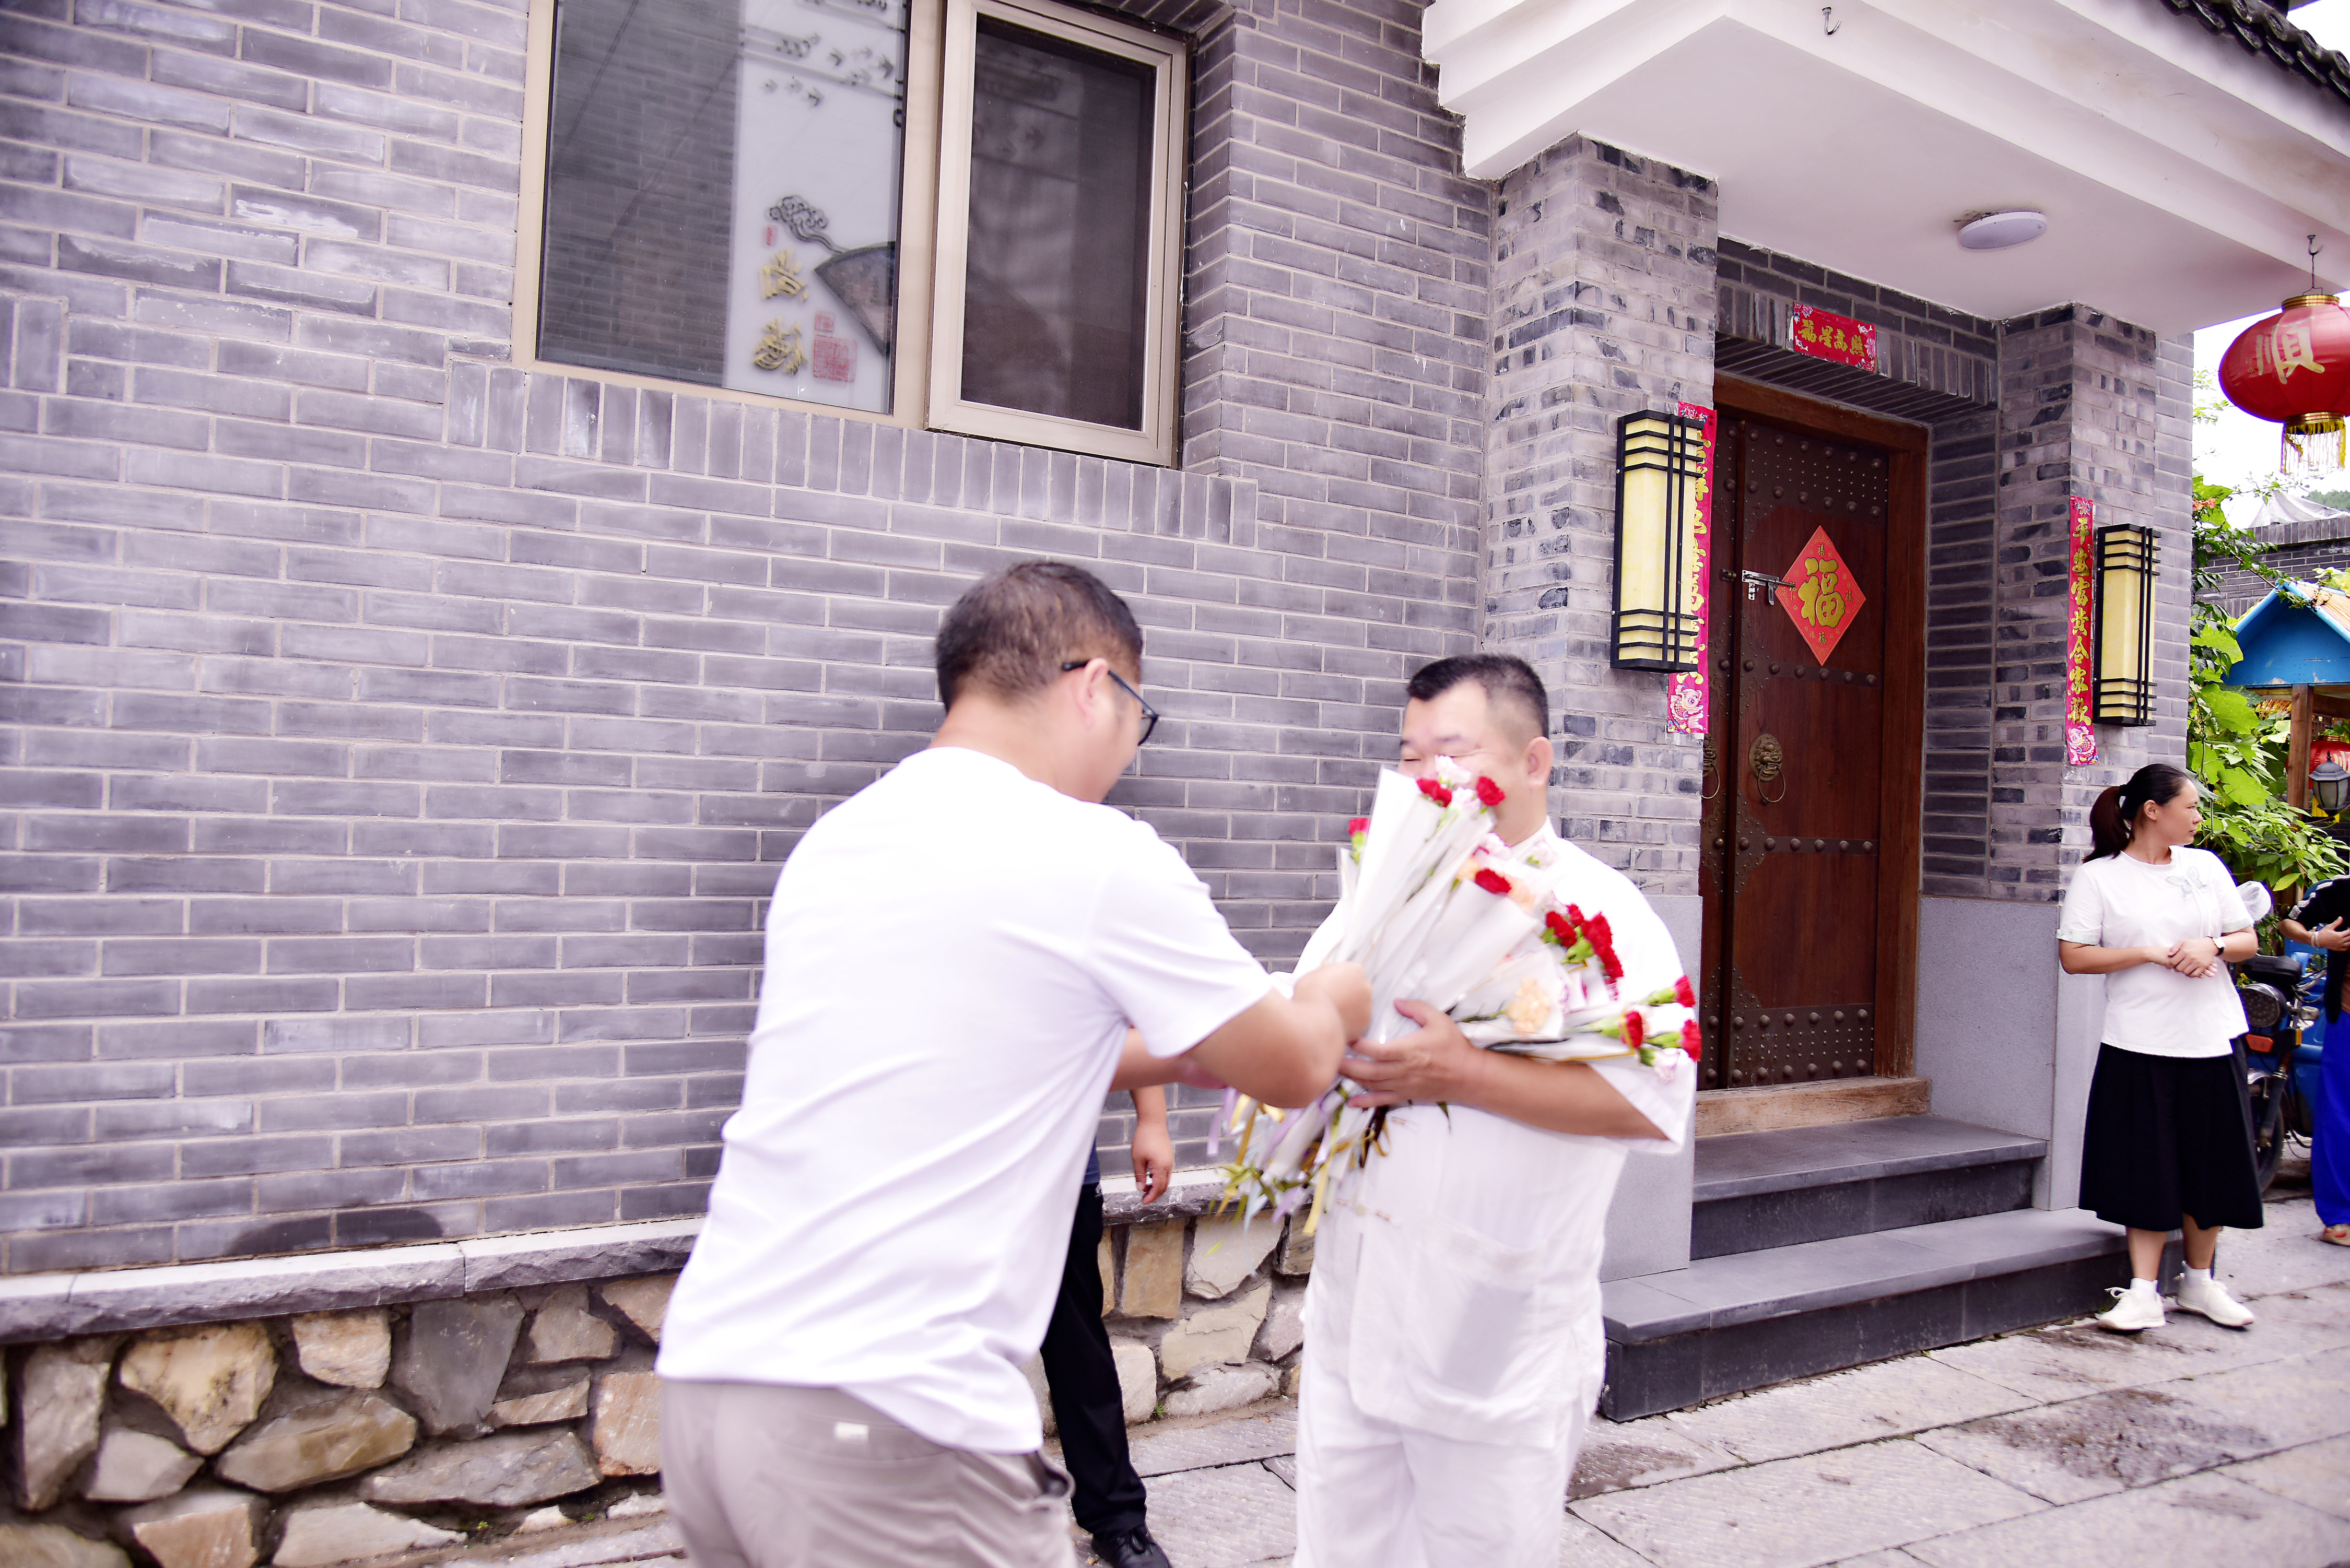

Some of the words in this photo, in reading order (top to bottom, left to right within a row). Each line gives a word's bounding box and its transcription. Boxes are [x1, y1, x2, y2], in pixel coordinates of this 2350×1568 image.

[1798, 319, 1865, 357] 福星高照
[1817, 544, 1825, 556] 福
[1797, 557, 1846, 628] 福
[1818, 632, 1827, 645] 福
